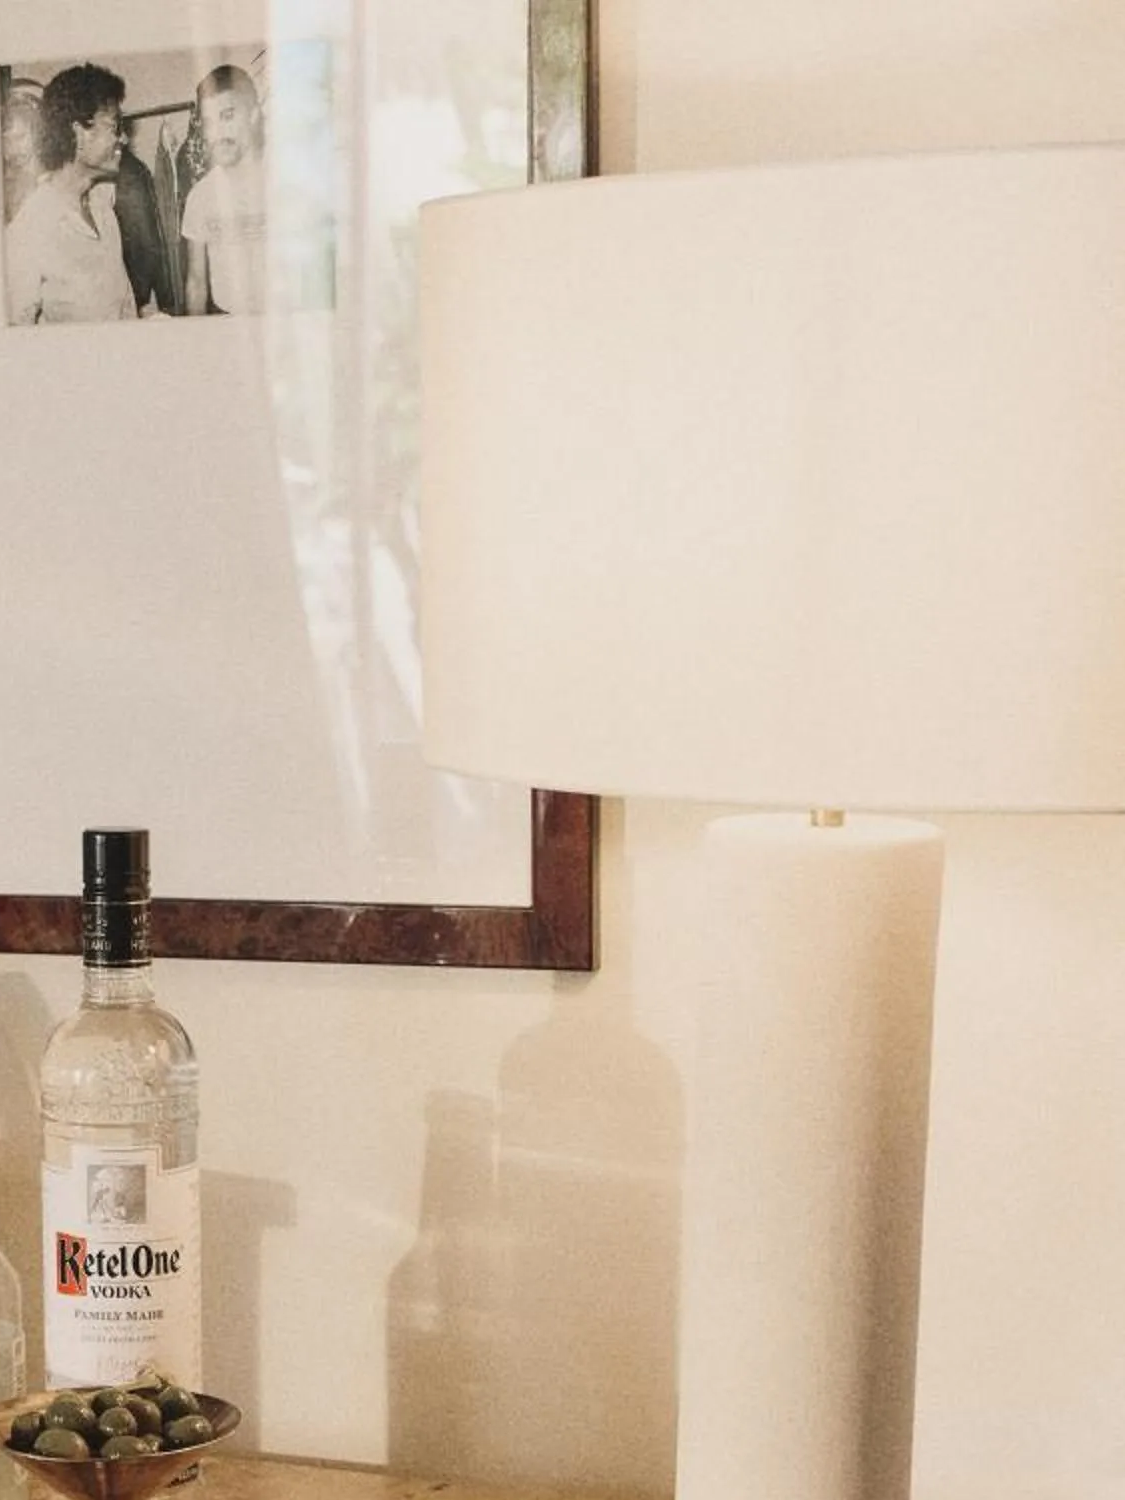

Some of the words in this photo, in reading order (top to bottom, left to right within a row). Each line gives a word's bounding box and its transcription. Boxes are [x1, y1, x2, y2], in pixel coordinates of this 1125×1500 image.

[59, 1239, 128, 1291] Ketel
[132, 1244, 181, 1278] One
[90, 1284, 152, 1299] VODKA
[74, 1309, 122, 1321] FAMILY
[126, 1309, 164, 1321] MADE
